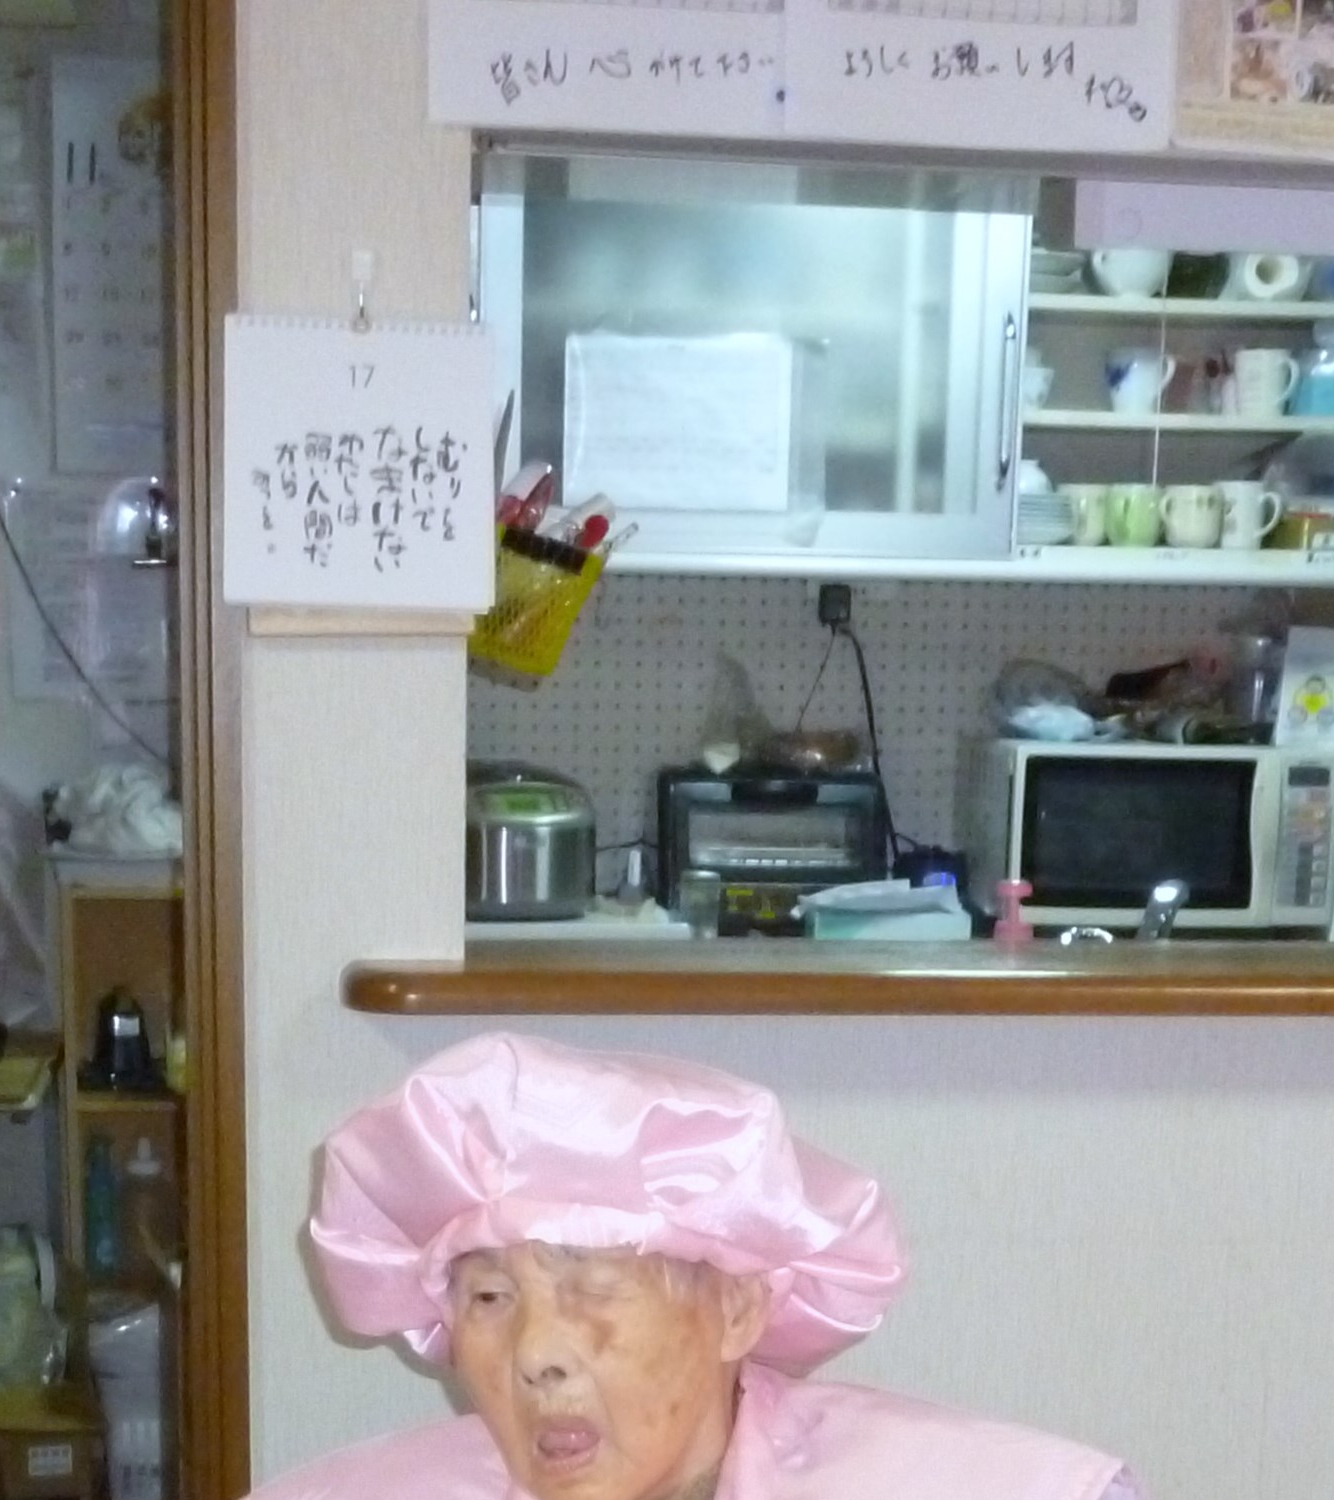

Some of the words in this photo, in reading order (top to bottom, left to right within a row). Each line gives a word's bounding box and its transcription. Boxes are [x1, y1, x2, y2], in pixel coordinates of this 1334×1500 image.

[349, 364, 375, 388] 17
[275, 441, 299, 499] から
[369, 424, 408, 573] なまけない
[408, 425, 435, 532] しないで
